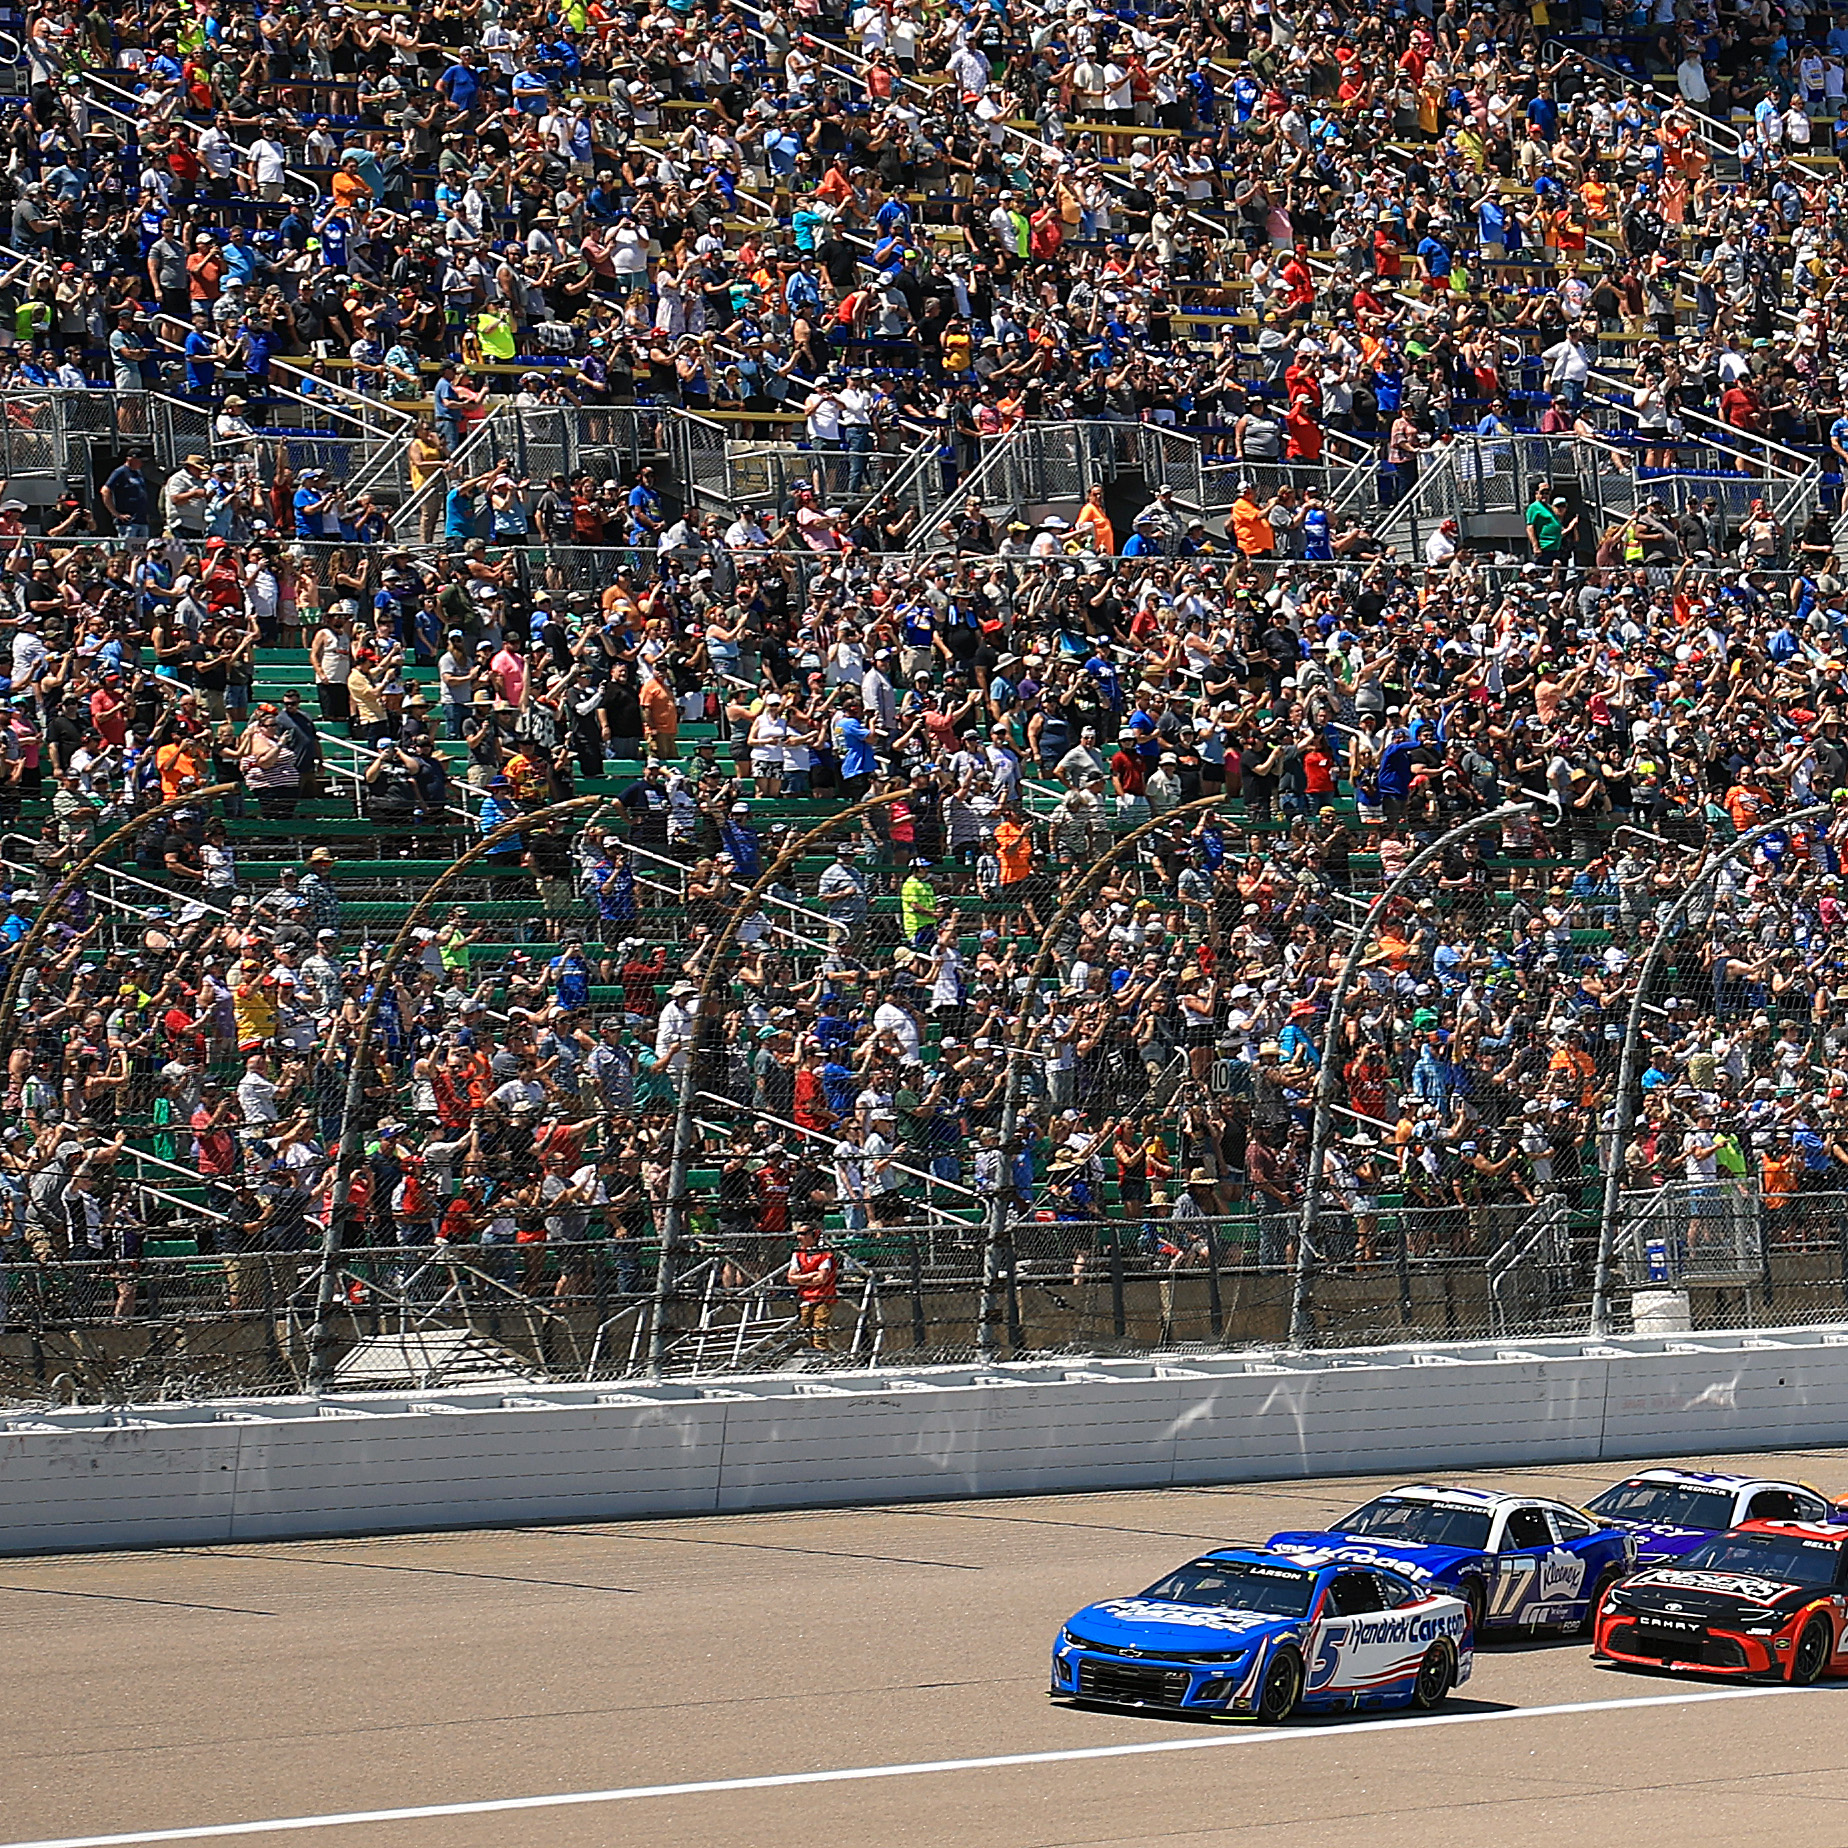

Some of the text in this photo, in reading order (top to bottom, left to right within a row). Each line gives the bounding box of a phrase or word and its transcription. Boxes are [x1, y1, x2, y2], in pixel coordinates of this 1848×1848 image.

[1213, 1063, 1228, 1090] 10
[1677, 1484, 1728, 1496] REDDICK
[1432, 1501, 1490, 1516] BUESCHER
[1802, 1540, 1834, 1551] BELL
[1249, 1567, 1302, 1582] LARSON
[1322, 1546, 1443, 1582] Kroger
[1487, 1554, 1537, 1619] 17
[1543, 1559, 1582, 1594] Kleenex
[1639, 1616, 1701, 1632] CAMRY
[1308, 1626, 1352, 1690] 5
